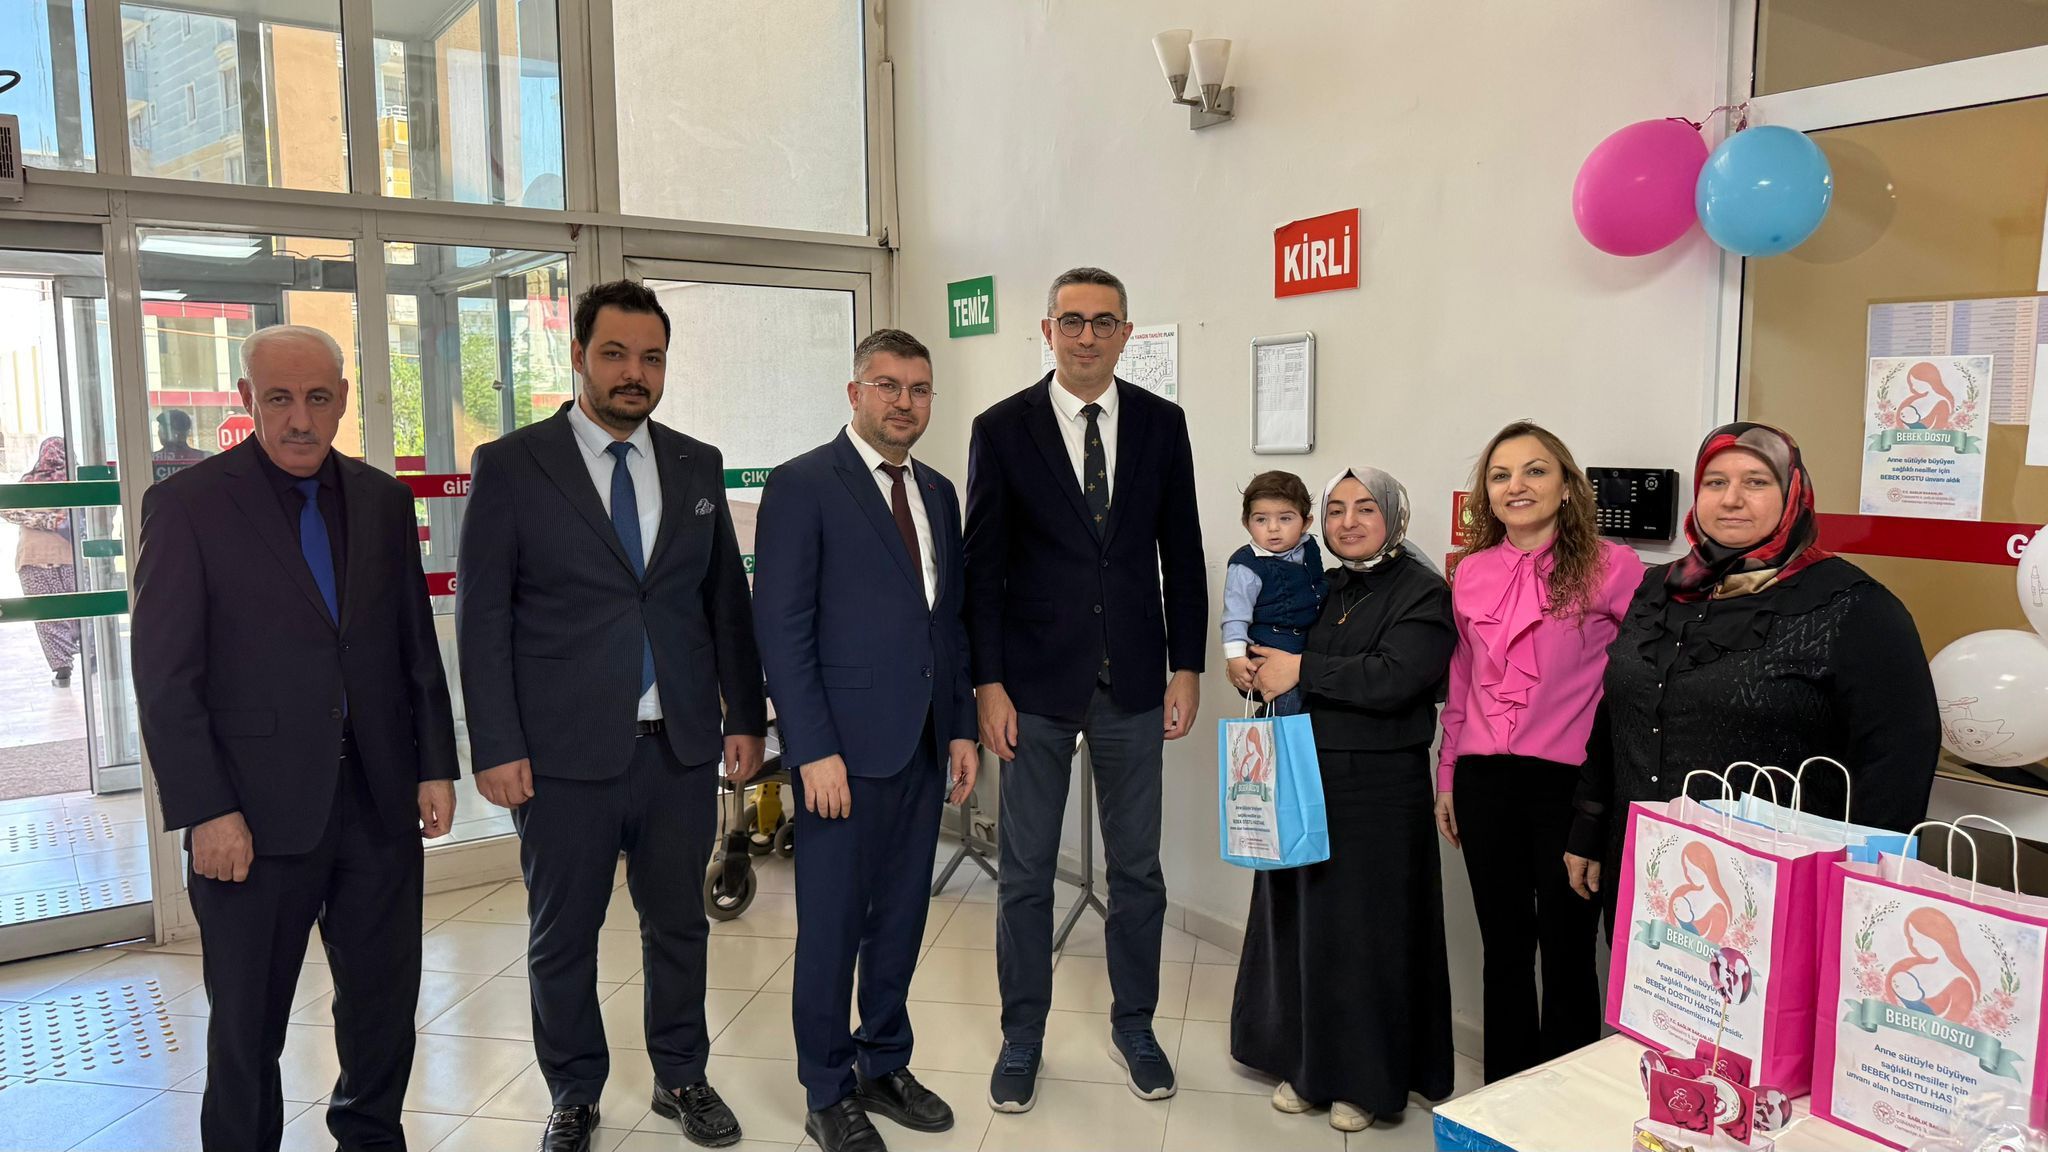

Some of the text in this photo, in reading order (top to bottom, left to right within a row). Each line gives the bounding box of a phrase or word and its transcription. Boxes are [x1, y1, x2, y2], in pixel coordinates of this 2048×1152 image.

[1284, 225, 1350, 283] KİRLİ
[953, 288, 989, 327] TEMİZ
[221, 428, 254, 446] DU
[1896, 432, 1951, 443] BEBEK DOSTU
[1928, 457, 1955, 466] büyüyen
[1938, 467, 1951, 475] için
[443, 477, 471, 495] GİR
[741, 470, 769, 487] ÇIK
[1666, 928, 1715, 959] BEBEK DOS
[1656, 959, 1673, 972] Anne
[1674, 967, 1698, 983] sütüyle
[1645, 976, 1667, 994] BEBEK
[1667, 987, 1693, 1005] DOSTU
[1660, 974, 1683, 989] sağlıklı
[1683, 985, 1707, 1000] nesiller
[1653, 992, 1666, 1004] alan
[1666, 997, 1706, 1021] hastanemizin
[1707, 1015, 1744, 1040] Hedyesidir.
[1886, 1008, 1975, 1049] BEBEK DOSTU
[1861, 1063, 1890, 1081] BEBEK
[1892, 1076, 1928, 1095] DOSTU
[1874, 1044, 1977, 1086] Anne sütüyle büyüyen
[1881, 1060, 1969, 1097] sağlıklı nesiller için
[1872, 1081, 1889, 1094] alan
[1890, 1086, 1948, 1114] hastanemizin
